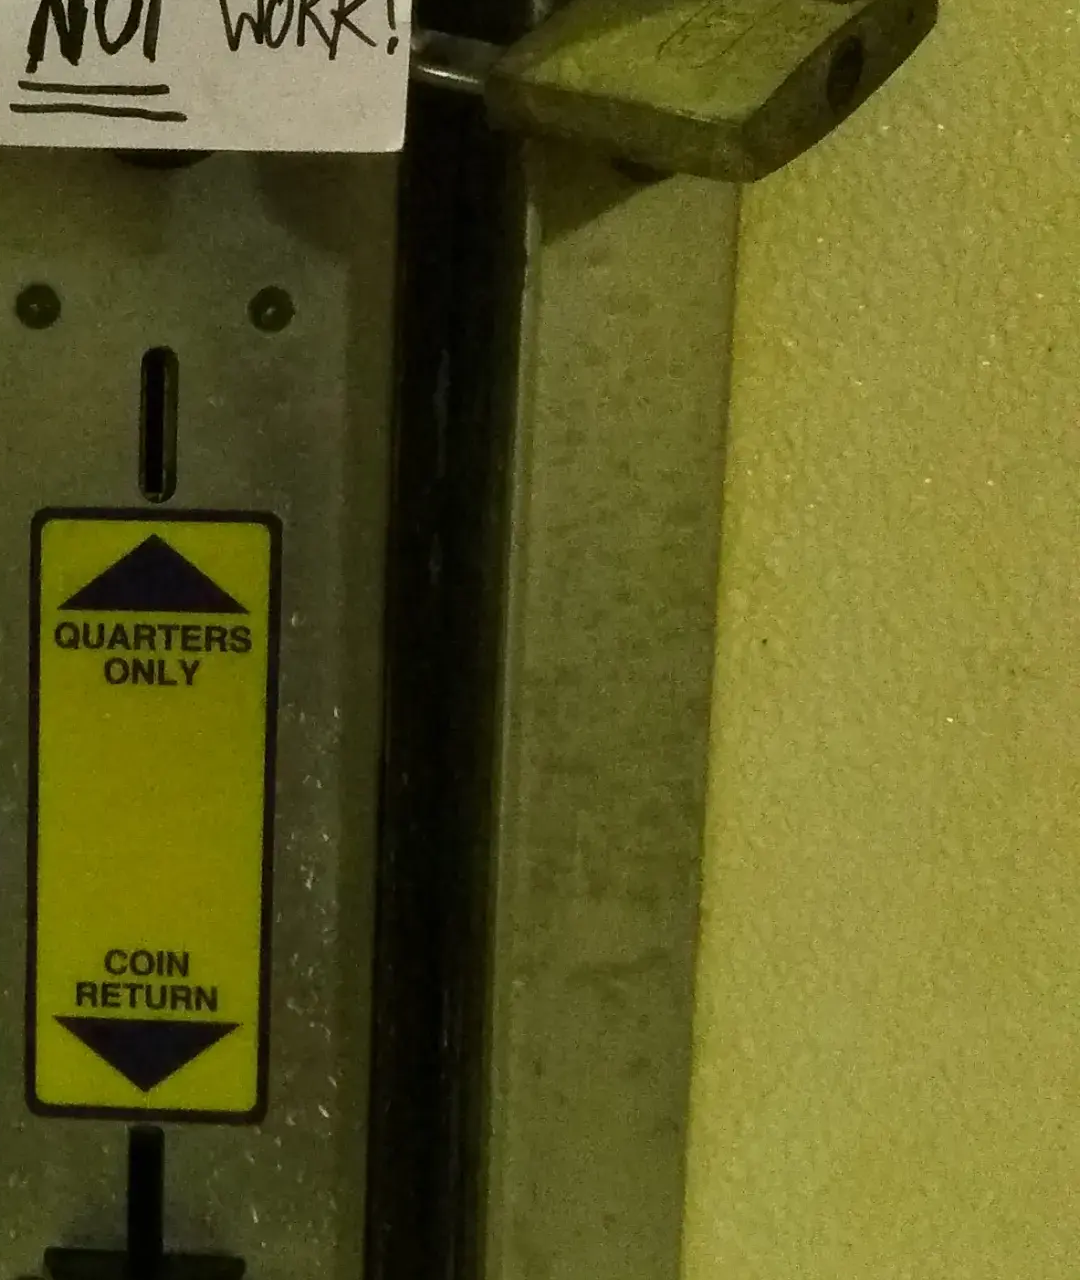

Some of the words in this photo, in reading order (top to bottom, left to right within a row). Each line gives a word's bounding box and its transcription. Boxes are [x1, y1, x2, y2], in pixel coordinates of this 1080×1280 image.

[53, 621, 253, 654] QUARTERS
[103, 657, 200, 687] ONLY
[104, 949, 190, 977] COIN
[76, 981, 219, 1012] RETURN
